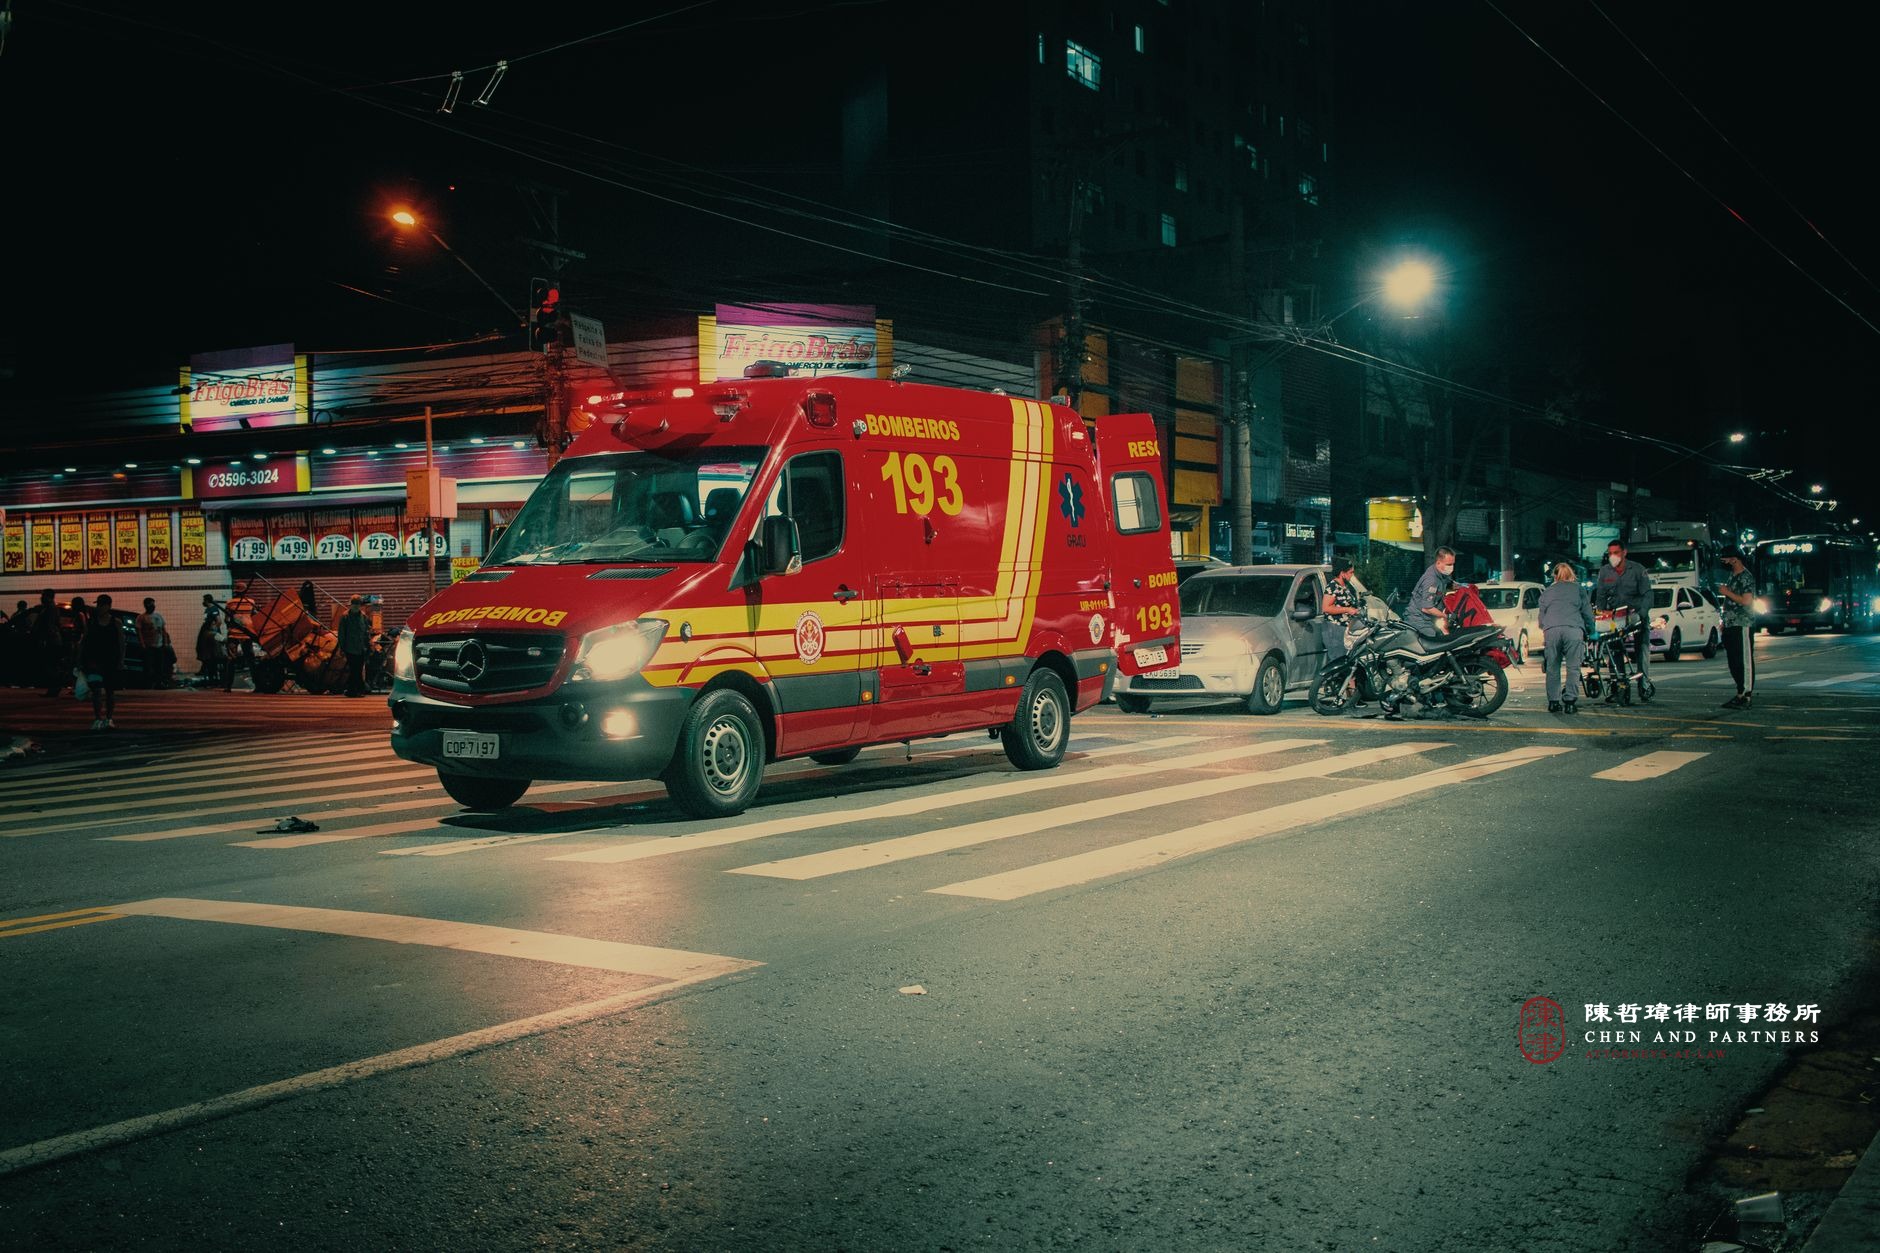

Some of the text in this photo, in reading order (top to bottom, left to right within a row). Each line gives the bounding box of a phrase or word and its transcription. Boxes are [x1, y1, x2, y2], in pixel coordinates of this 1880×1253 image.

[193, 374, 292, 405] FrigoBrás
[865, 414, 960, 440] BOMBEIROS
[218, 468, 279, 488] 3596-3024
[881, 451, 964, 516] 193
[452, 557, 479, 567] OFERTA
[1136, 602, 1172, 632] 193
